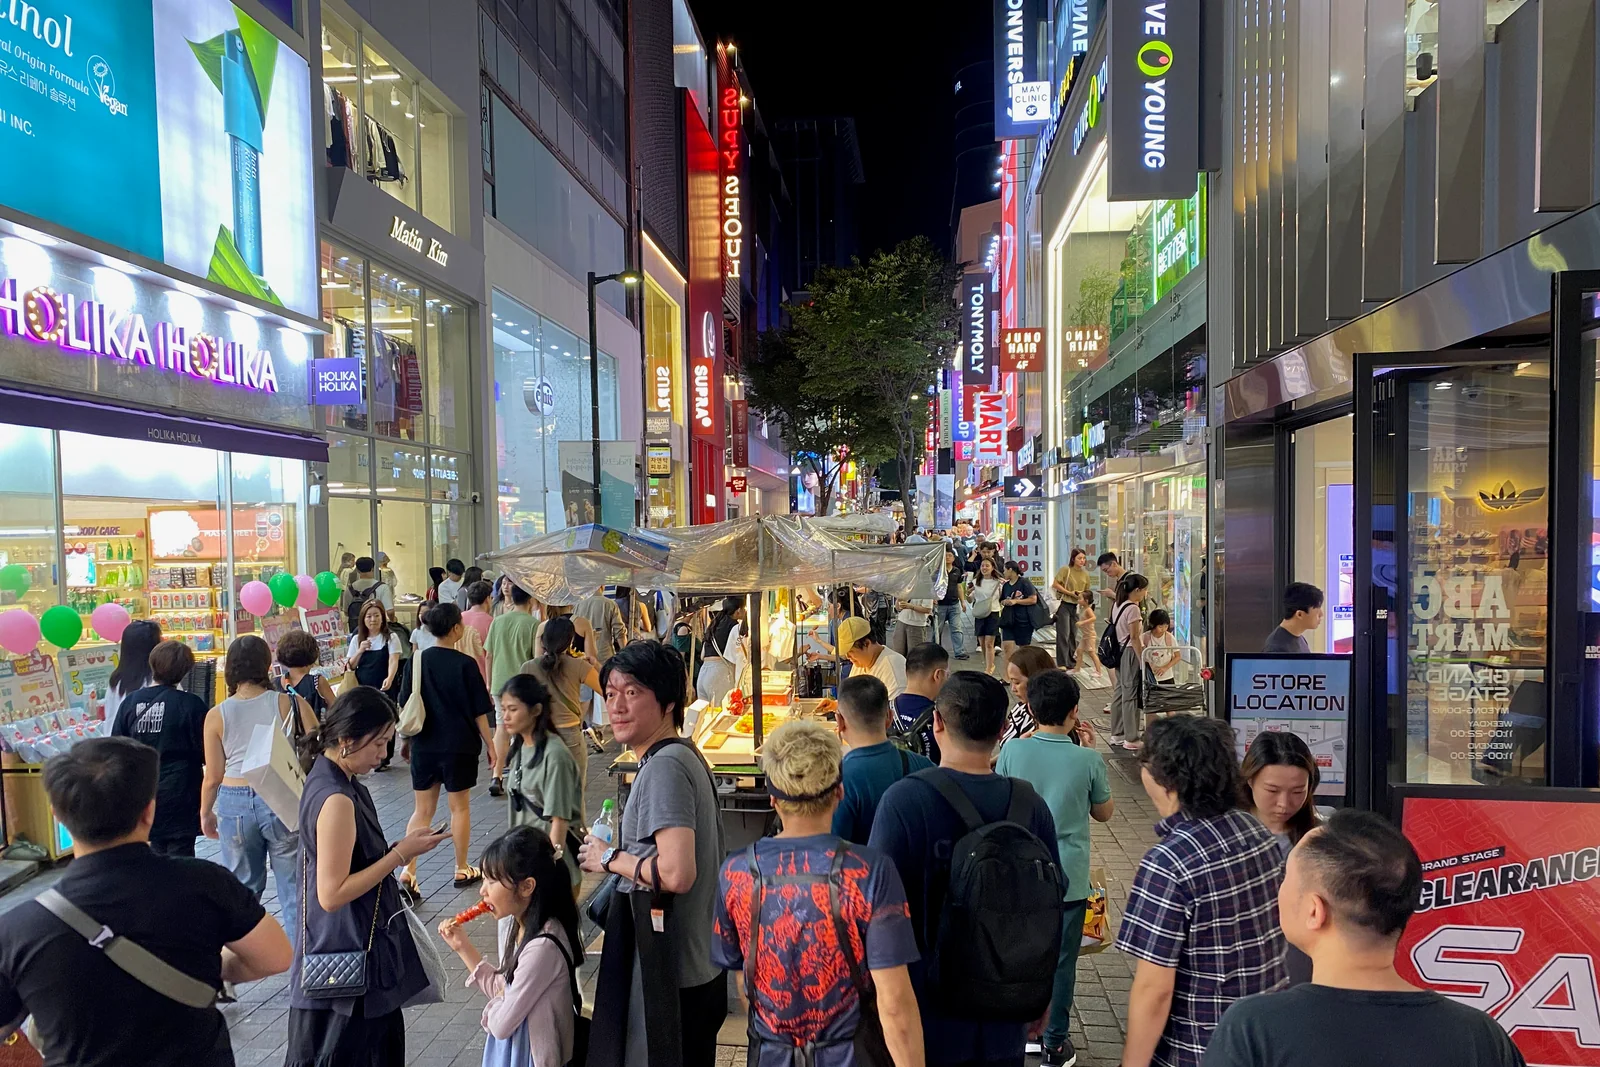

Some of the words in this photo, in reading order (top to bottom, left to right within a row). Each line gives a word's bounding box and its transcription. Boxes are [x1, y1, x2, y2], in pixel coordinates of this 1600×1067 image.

[1007, 0, 1024, 98] ONVERS
[14, 45, 47, 72] Origin
[48, 63, 90, 96] Formula
[19, 69, 48, 98] 리페어
[49, 87, 76, 112] 솔루션
[94, 82, 128, 116] Vegan
[1014, 93, 1048, 104] CLINIC
[1021, 85, 1041, 93] MAY
[1026, 106, 1037, 115] 3F
[10, 113, 36, 138] INC.
[1144, 78, 1166, 168] YOUNG
[1157, 203, 1176, 246] LIVE
[389, 215, 424, 253] Matin
[426, 237, 449, 267] Kim
[1157, 227, 1188, 278] BETTER
[0, 278, 155, 366] HOLIKA
[165, 321, 279, 393] HOLIKA
[971, 282, 984, 375] TONYMOLY
[1005, 331, 1042, 344] JUNO
[1008, 342, 1037, 354] HAIR
[1016, 360, 1029, 370] 4F
[318, 371, 357, 382] HOLIKA
[319, 381, 357, 392] HOLIKA
[694, 364, 709, 420] SUPRA
[148, 427, 175, 441] HOLIKA
[176, 432, 202, 444] HOLIKA
[979, 394, 1002, 457] MART
[1433, 446, 1468, 462] ABC
[1433, 463, 1468, 473] MART
[99, 526, 121, 536] CARE
[203, 529, 226, 537] MASK
[1017, 513, 1029, 573] JUNO
[1032, 513, 1042, 572] HAIR
[1252, 674, 1327, 690] STORE
[1233, 694, 1346, 711] LOCATION
[1461, 848, 1500, 864] STAGE
[1414, 846, 1600, 913] CLEARANC
